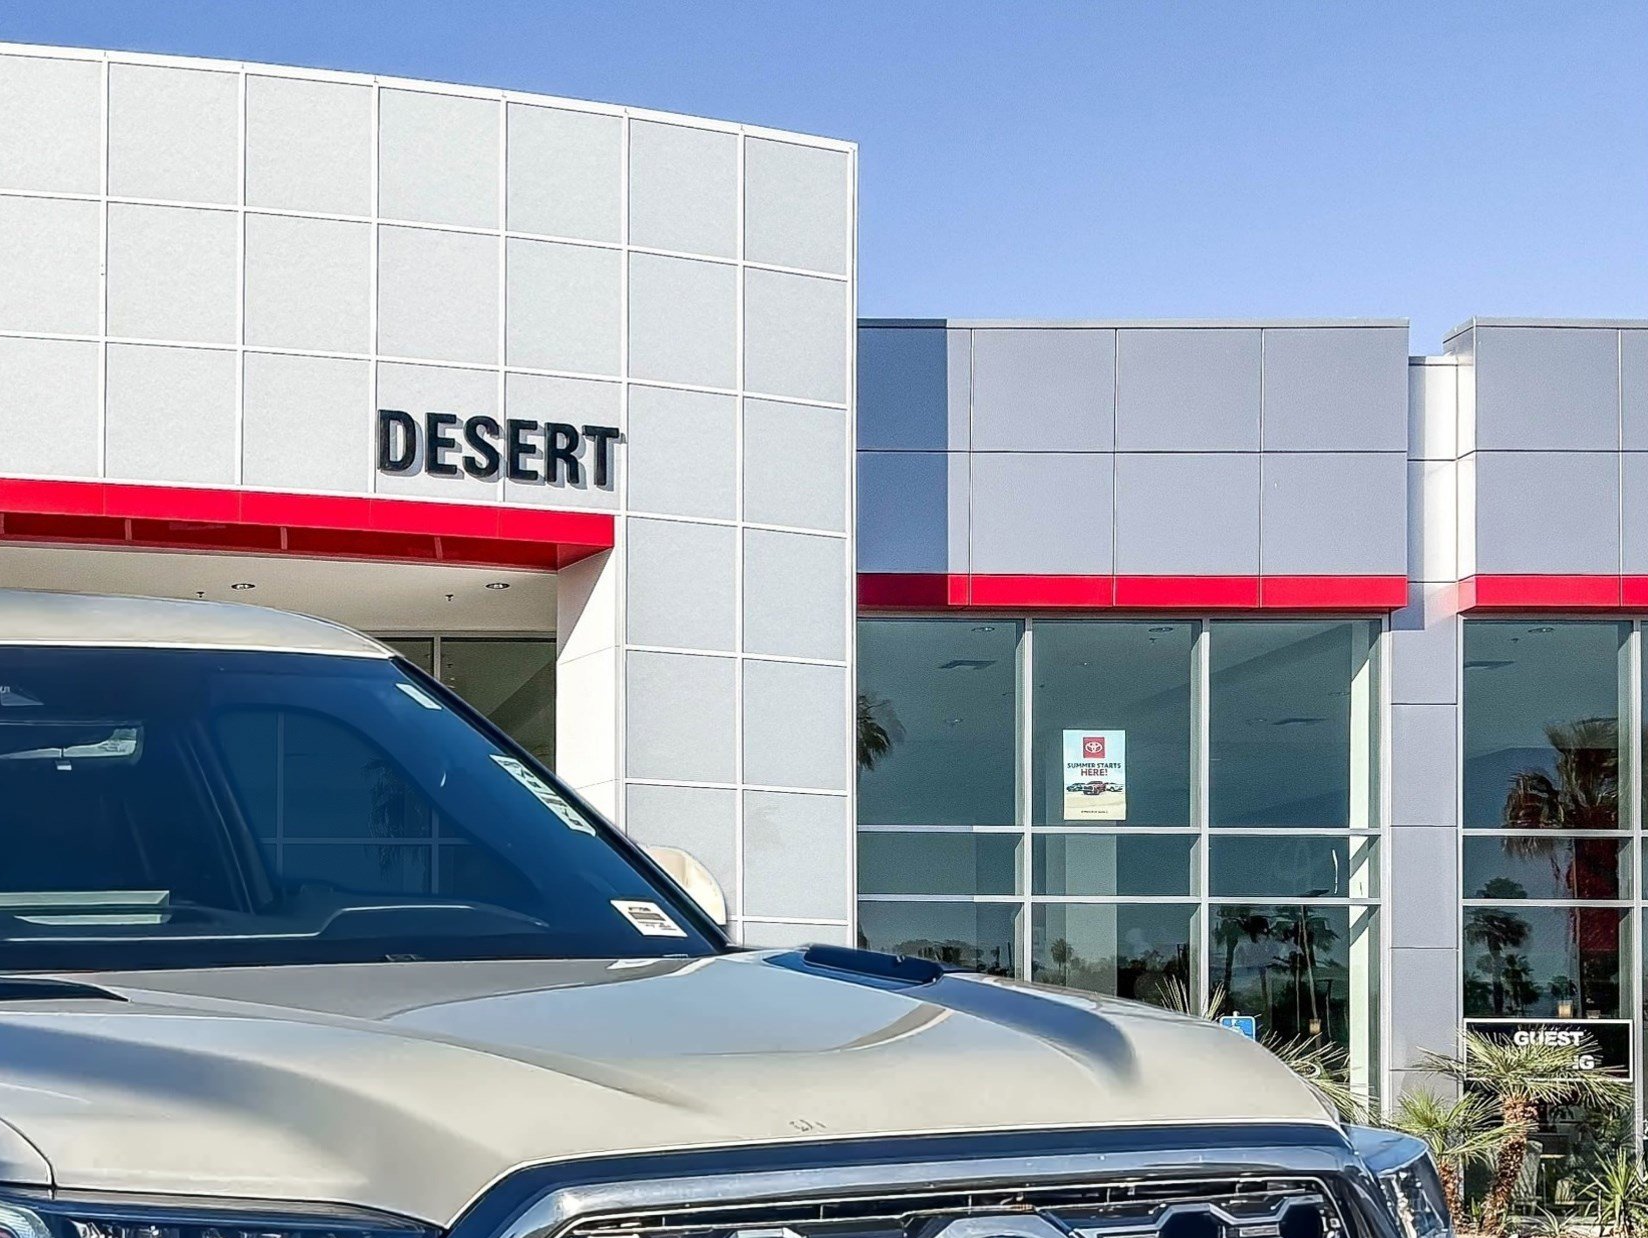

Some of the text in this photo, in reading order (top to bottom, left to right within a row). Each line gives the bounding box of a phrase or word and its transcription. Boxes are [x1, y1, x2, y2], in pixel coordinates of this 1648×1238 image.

[377, 409, 620, 487] DESERT
[1080, 768, 1108, 777] HERE!
[1513, 1031, 1585, 1046] GUEST
